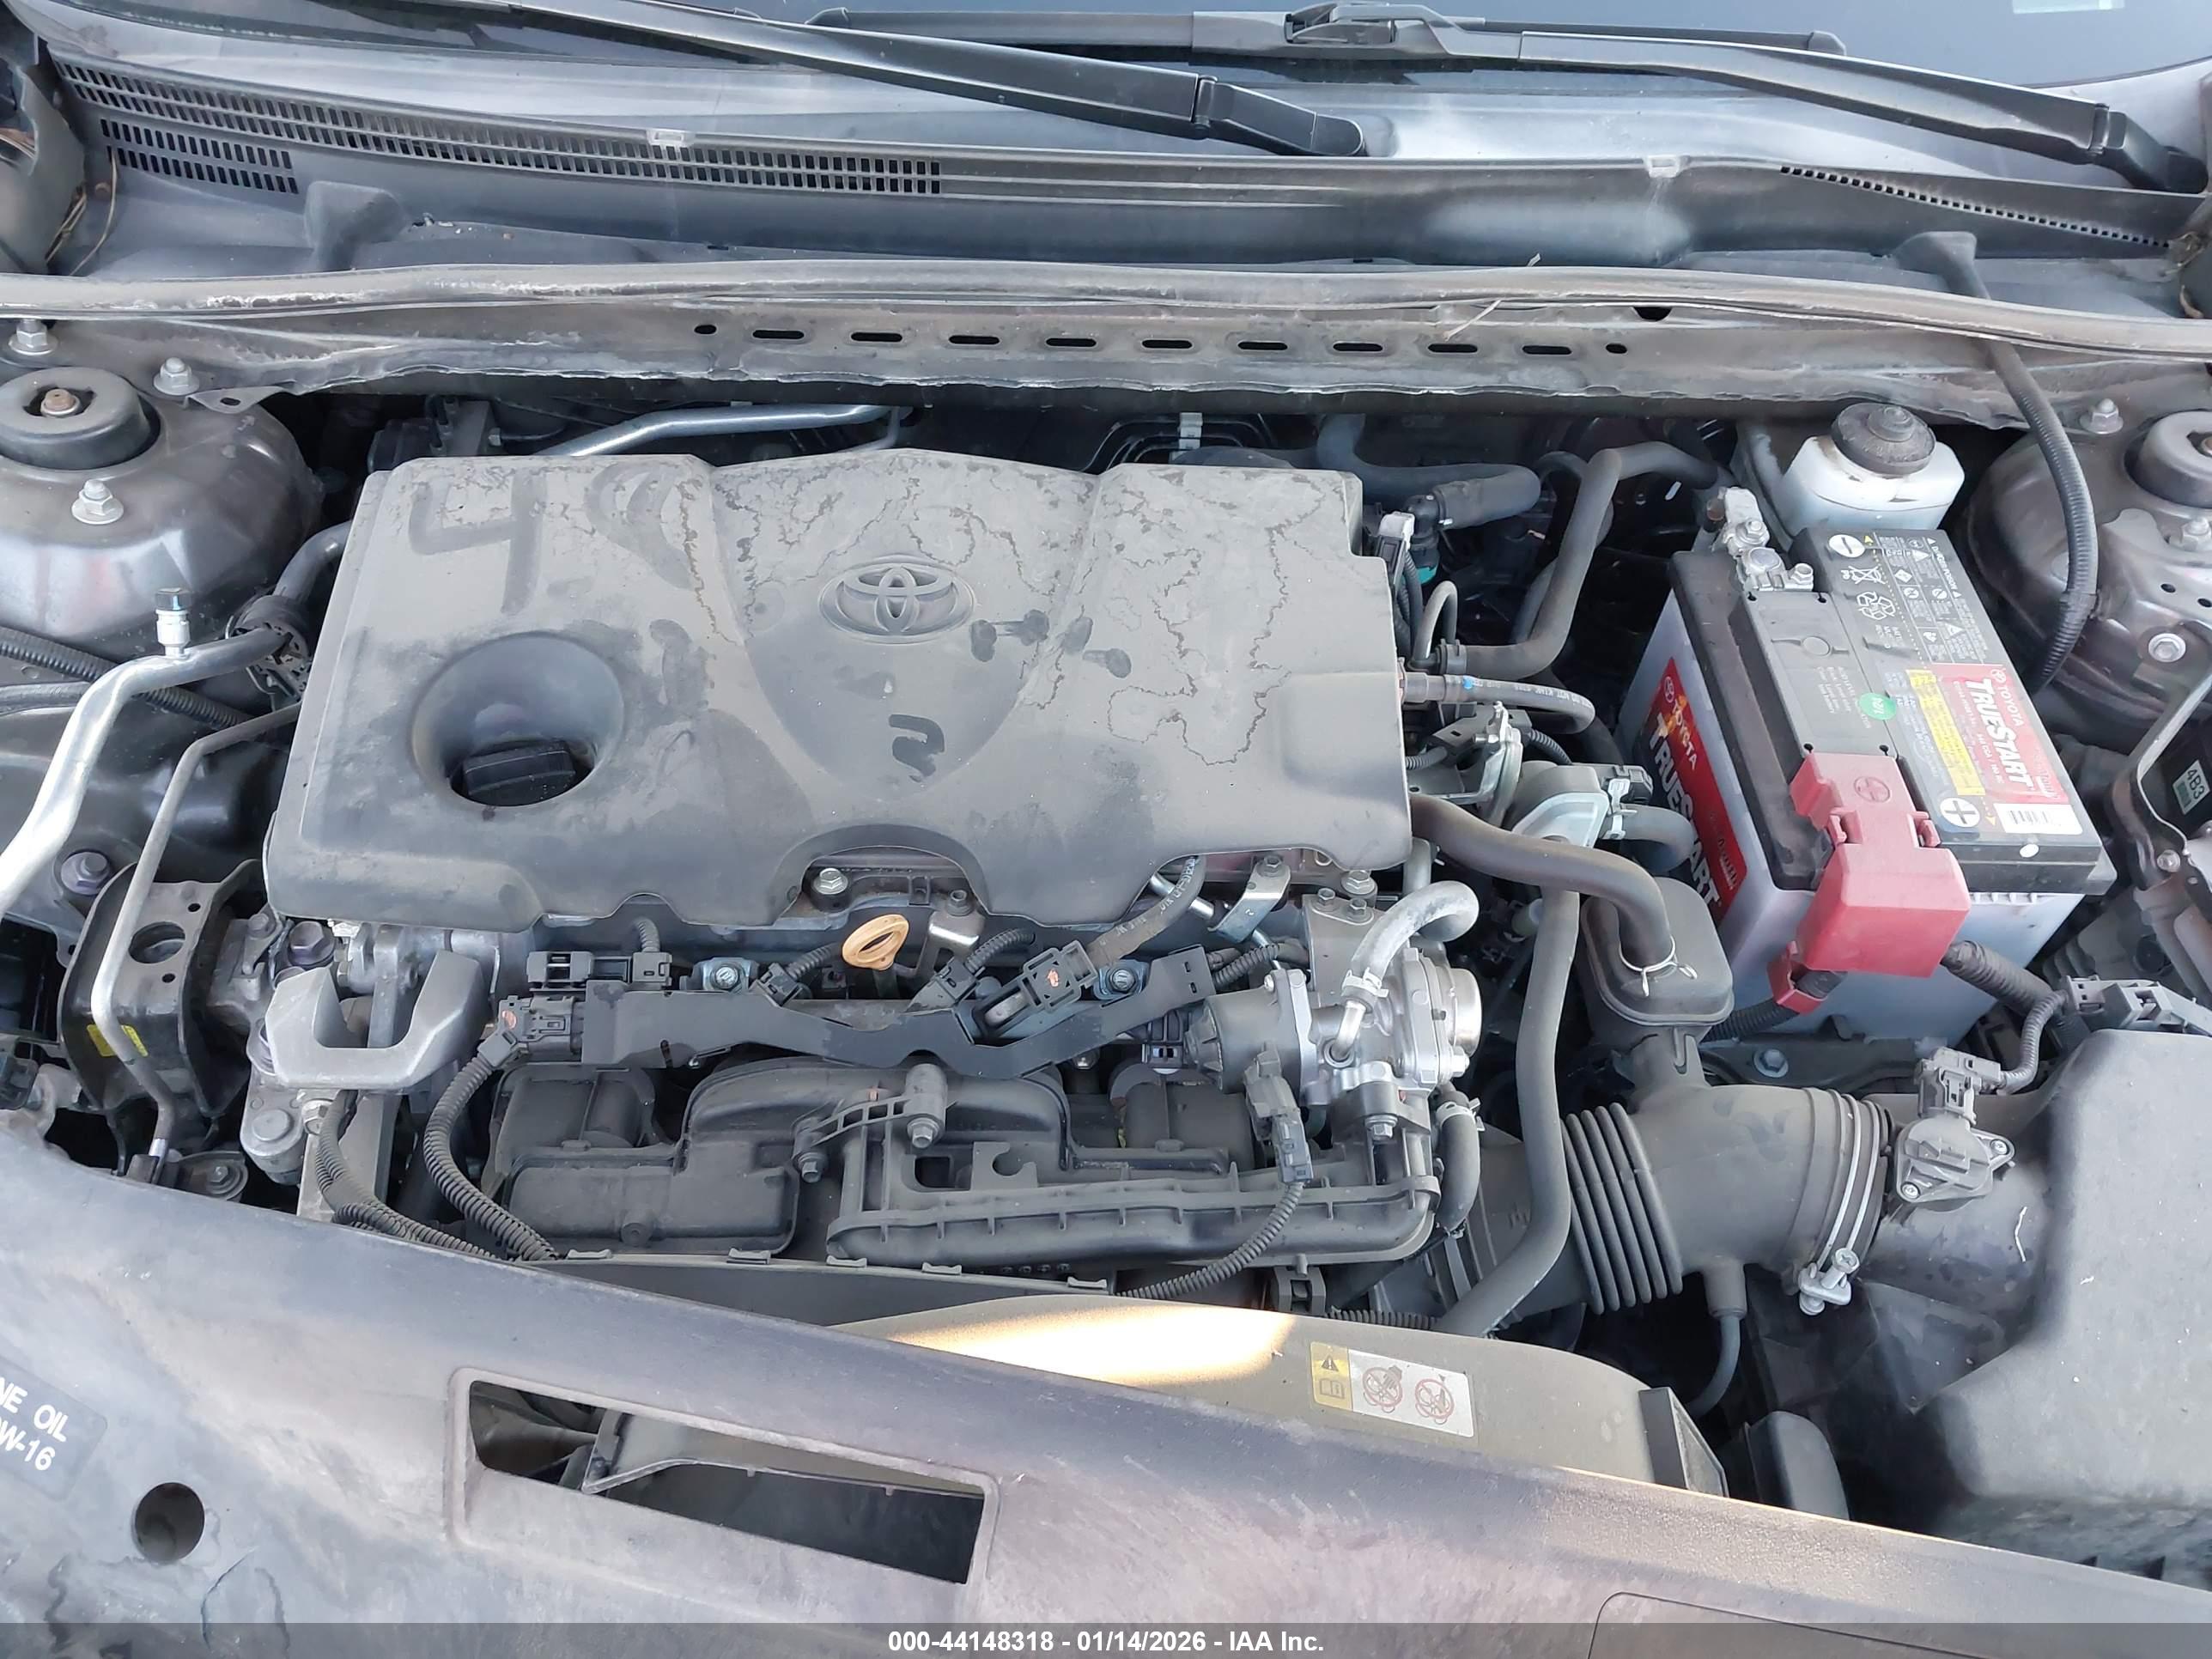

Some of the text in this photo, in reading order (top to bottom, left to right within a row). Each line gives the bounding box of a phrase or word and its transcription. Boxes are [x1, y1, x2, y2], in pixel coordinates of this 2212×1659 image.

[1998, 686, 2024, 726] TOYOTA
[1672, 699, 1697, 770] TOYOTA
[2187, 769, 2205, 800] 4B3
[1649, 712, 1721, 907] TRUESART
[0, 1419, 56, 1471] W-16
[33, 1404, 69, 1443] OIL
